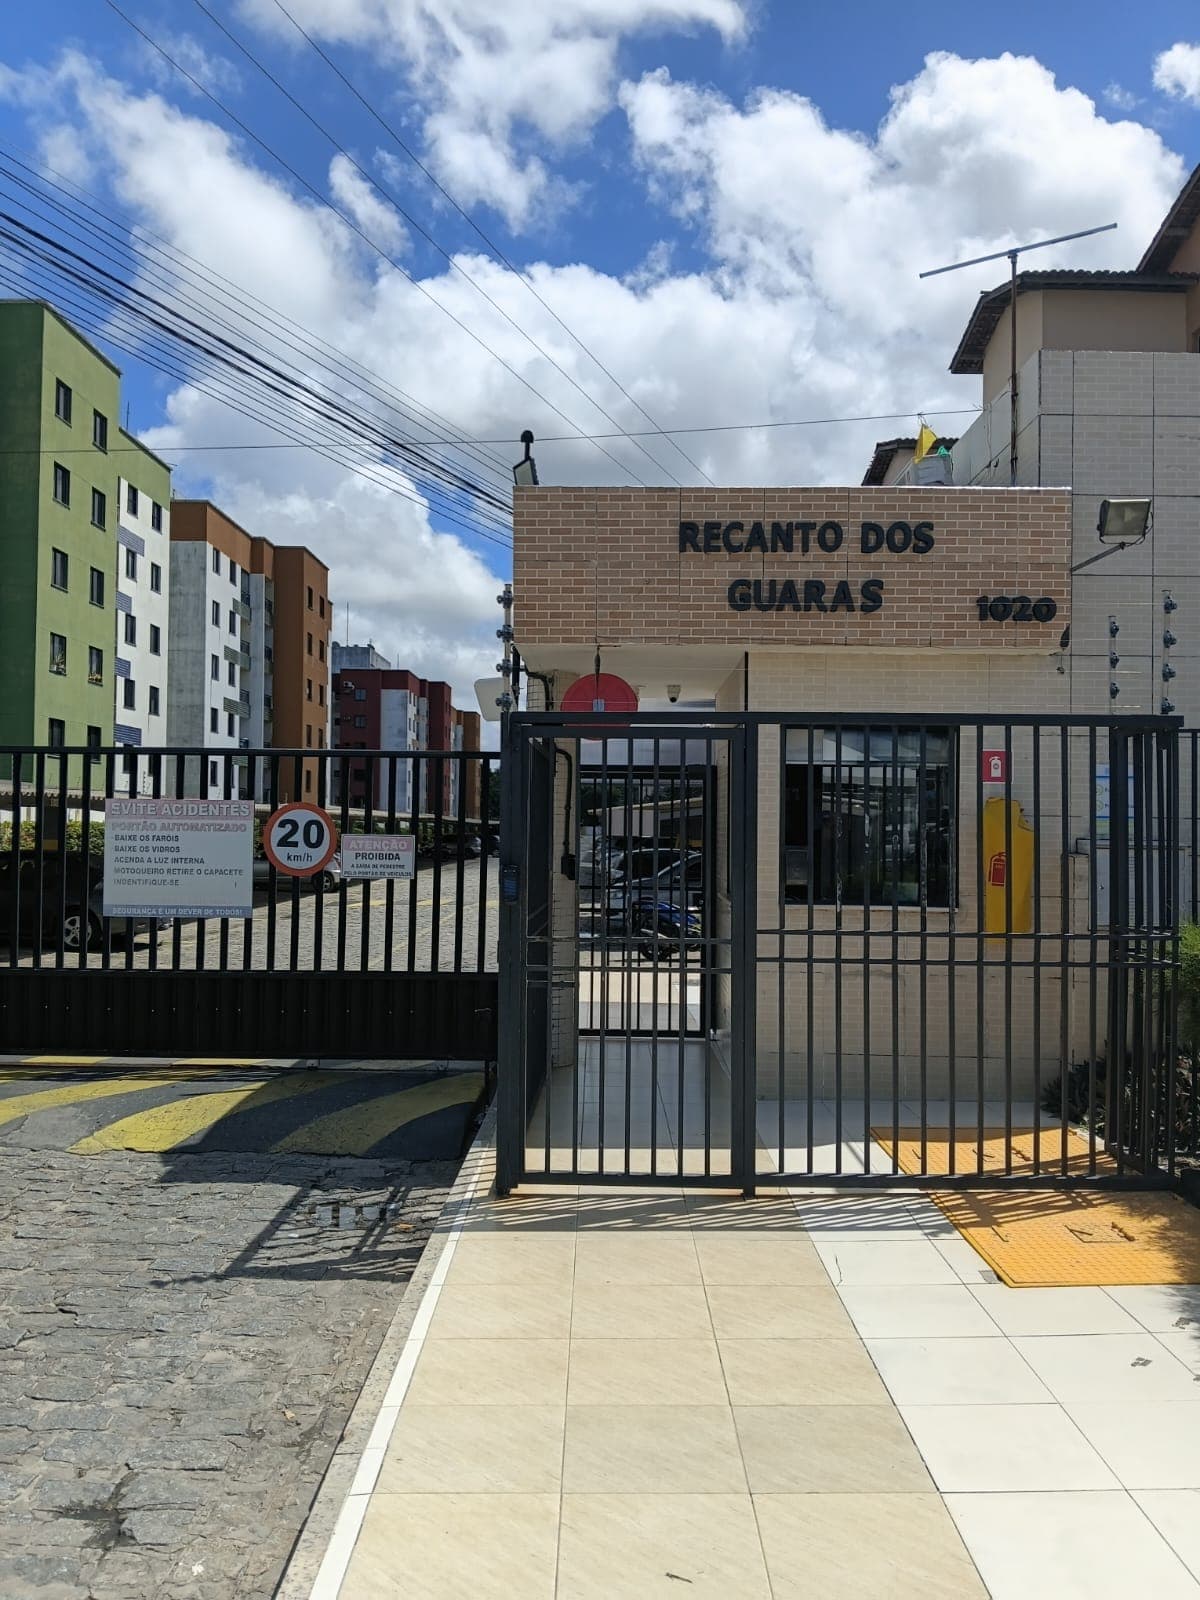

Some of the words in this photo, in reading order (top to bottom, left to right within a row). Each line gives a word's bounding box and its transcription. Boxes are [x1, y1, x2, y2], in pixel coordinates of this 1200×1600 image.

[679, 521, 843, 553] RECANTO
[861, 521, 934, 553] DOS
[728, 579, 884, 613] GUARAS
[976, 595, 1057, 623] 1020
[111, 802, 157, 815] EVITE
[161, 803, 249, 816] ACIDENTES
[111, 820, 157, 832] PORTÃO
[160, 822, 247, 832] AUTOMATIZADO
[114, 834, 137, 842] BAIXE
[139, 834, 150, 842] OS
[276, 819, 325, 849] 20
[114, 845, 137, 853] BAIXE
[139, 845, 150, 853] OS
[349, 838, 408, 851] ATENÇÃO
[114, 856, 145, 864] ACENDA
[171, 857, 205, 865] INTERNA
[286, 851, 313, 863] km/h
[354, 852, 401, 861] PROIBIDA
[113, 867, 165, 875] MOTOQUEIRO
[204, 868, 243, 876] CAPACETE
